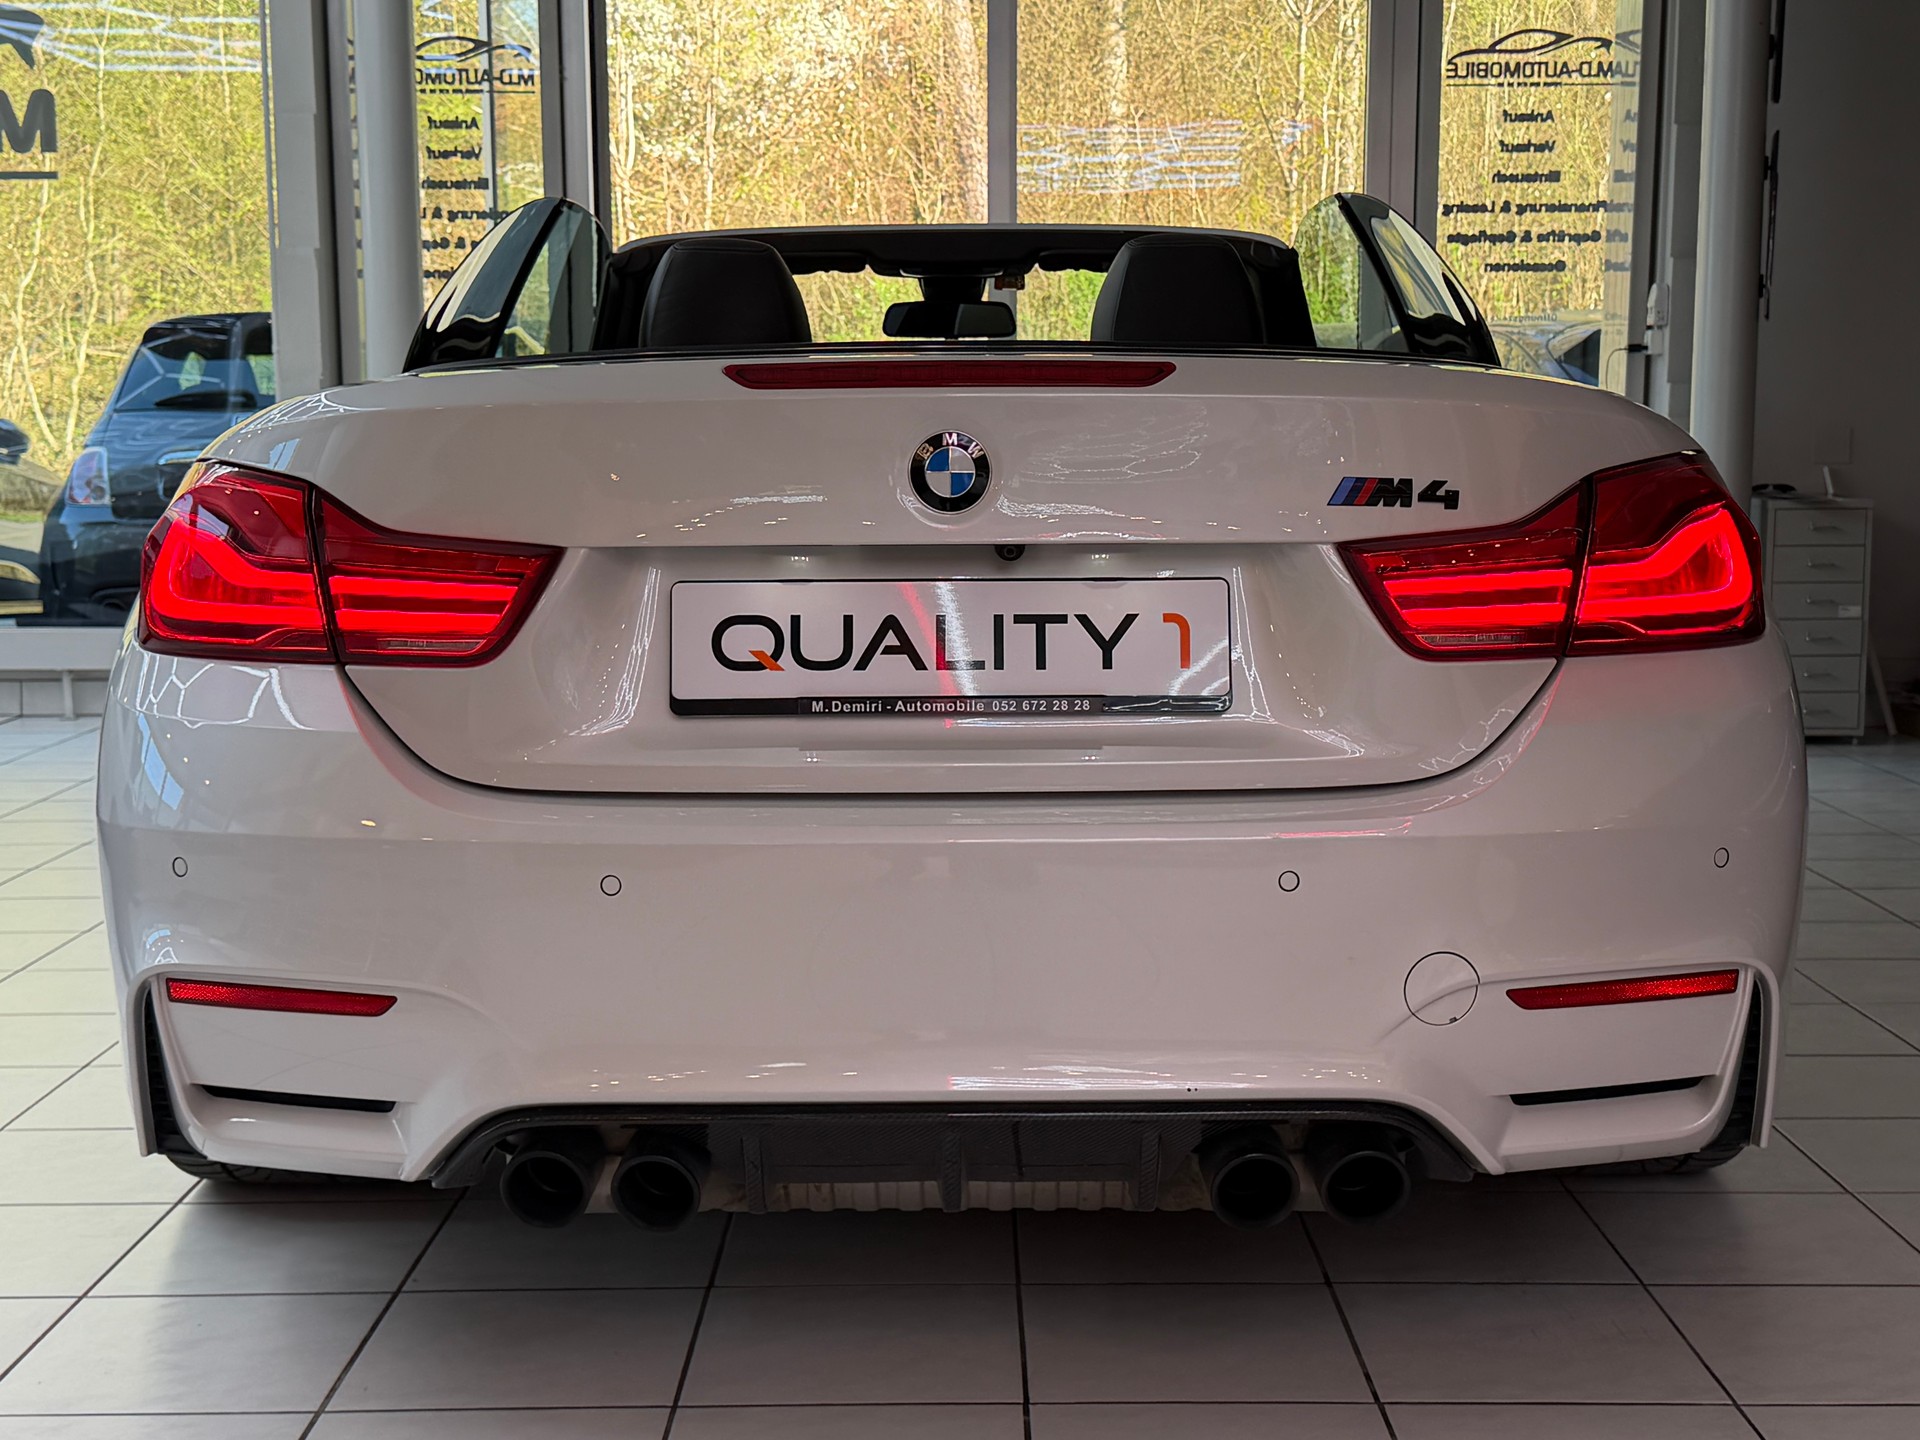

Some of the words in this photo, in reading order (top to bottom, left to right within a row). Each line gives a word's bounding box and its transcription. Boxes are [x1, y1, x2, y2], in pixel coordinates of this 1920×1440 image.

[917, 432, 984, 459] BMW
[711, 613, 1140, 672] QUALITY
[1162, 612, 1192, 669] 1
[894, 700, 985, 712] Automobile
[992, 700, 1017, 712] 052
[1022, 700, 1047, 712] 672
[1052, 700, 1069, 712] 28
[1074, 699, 1091, 711] 28
